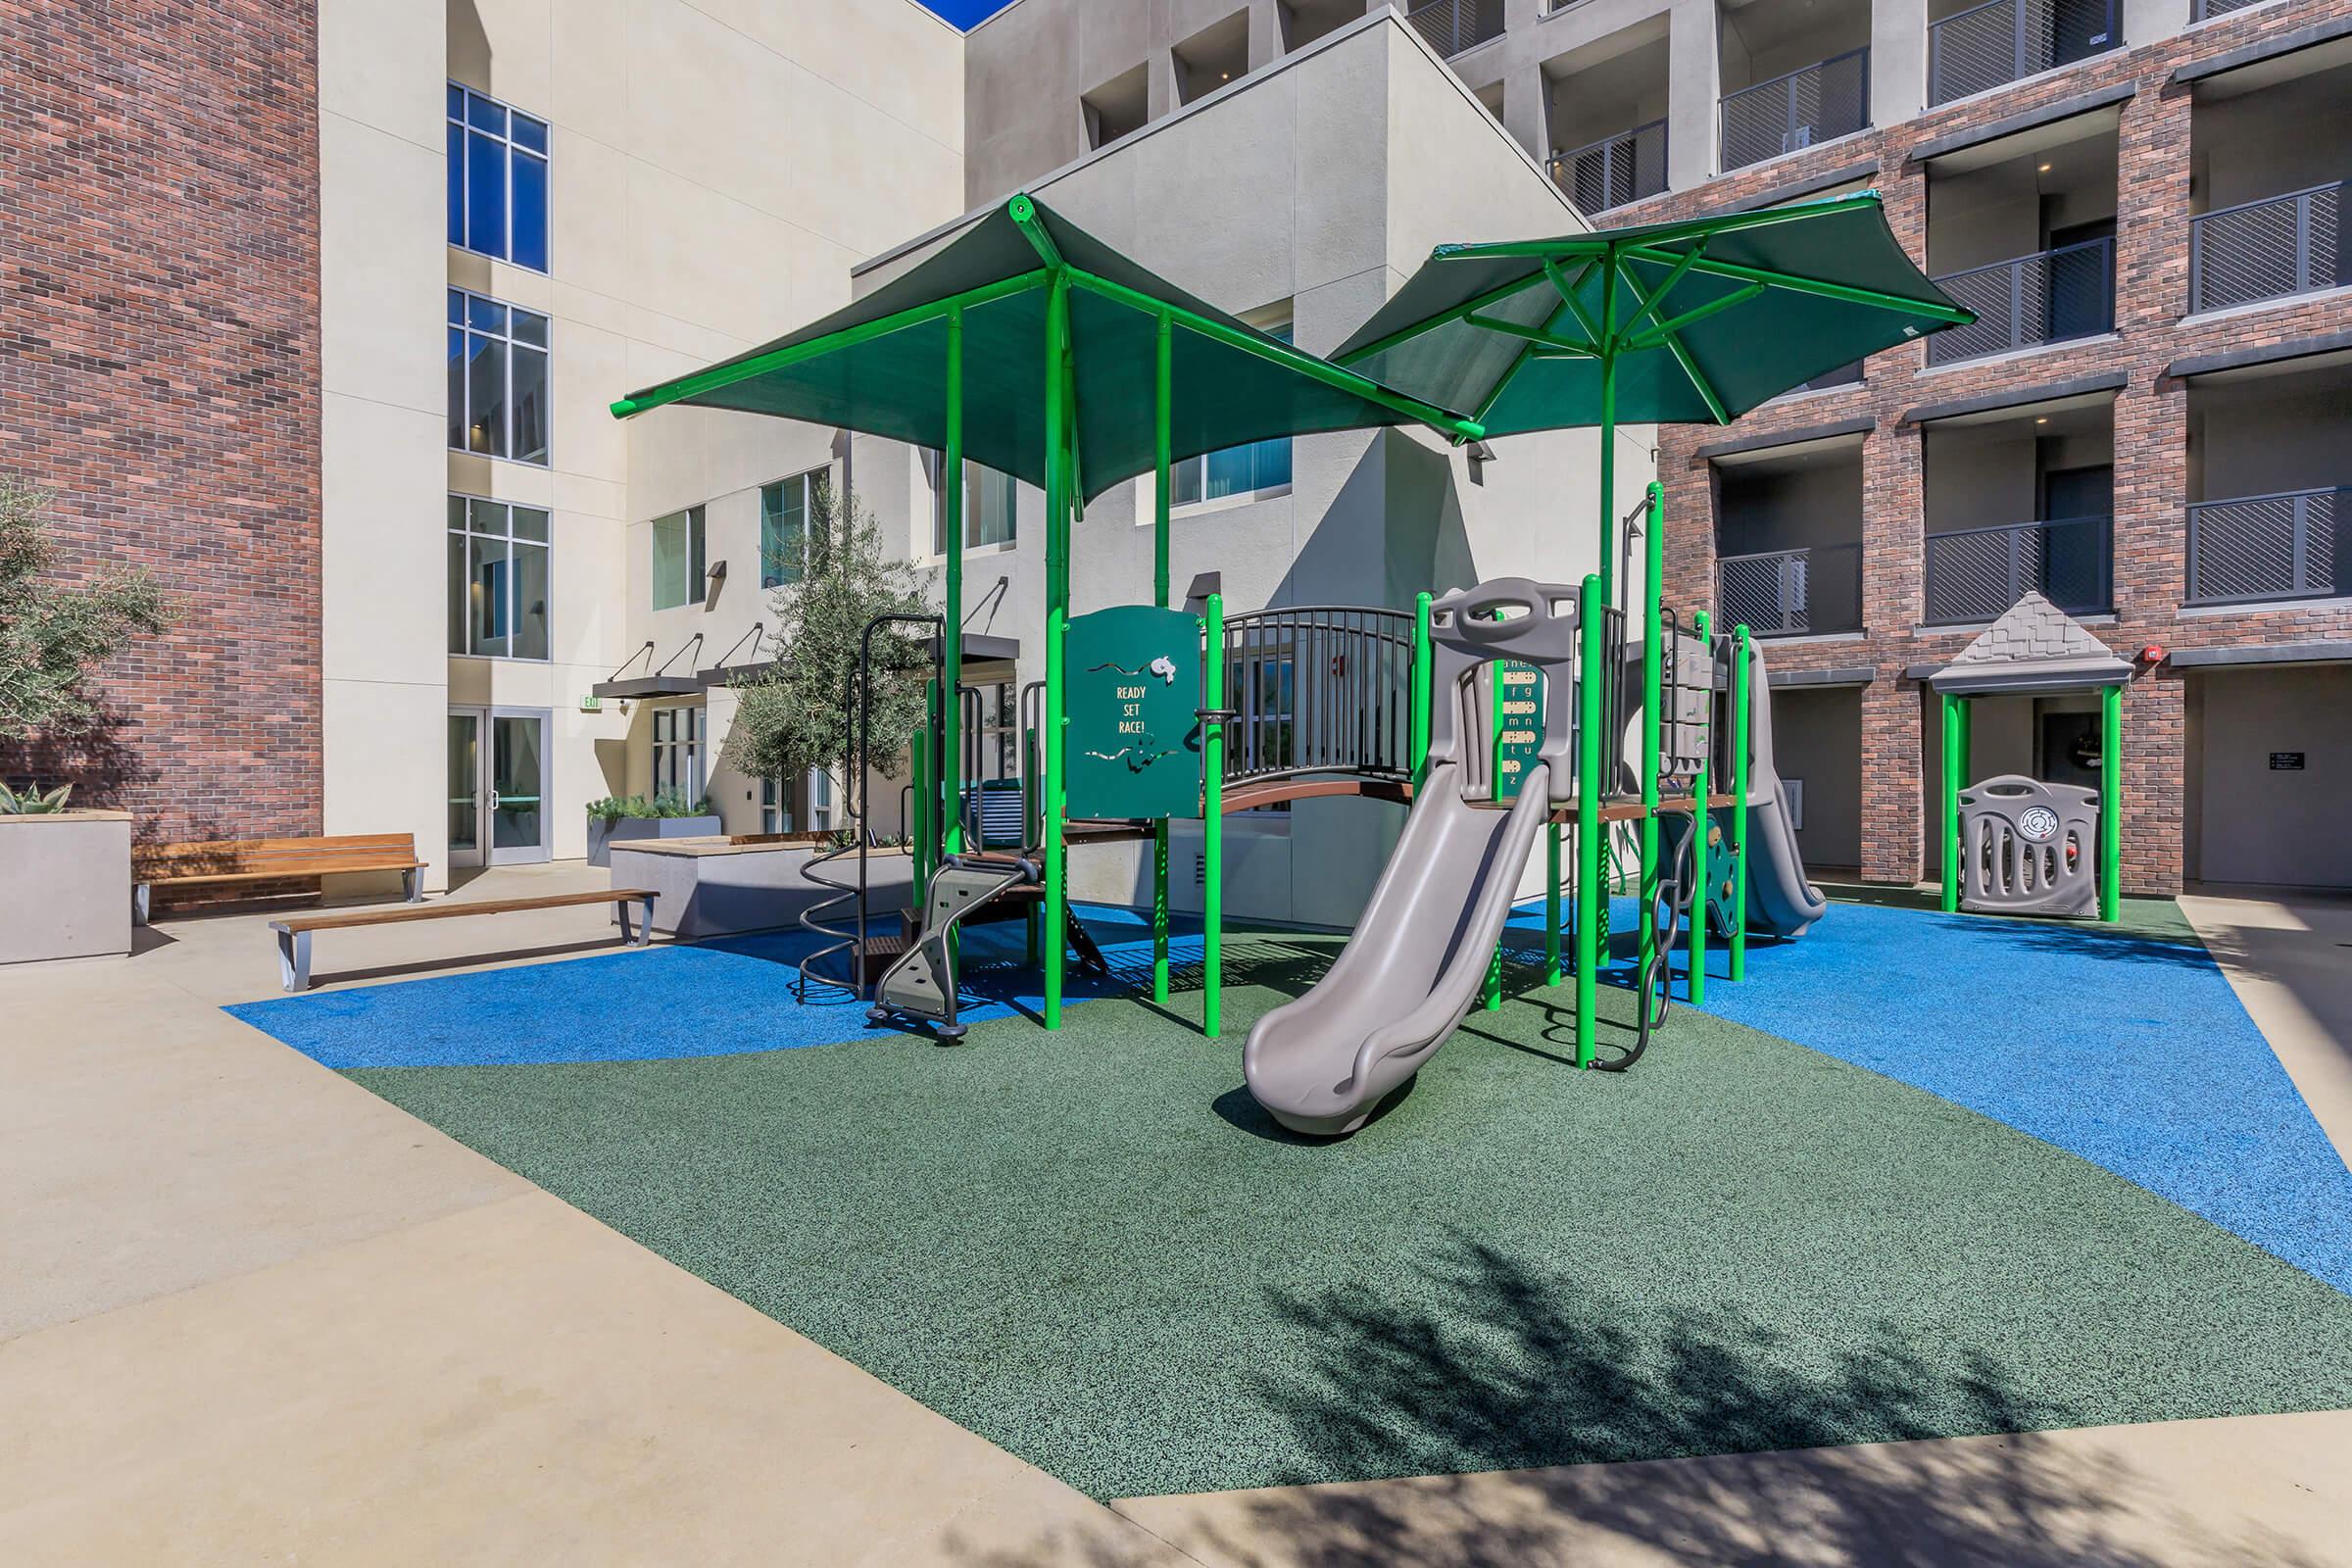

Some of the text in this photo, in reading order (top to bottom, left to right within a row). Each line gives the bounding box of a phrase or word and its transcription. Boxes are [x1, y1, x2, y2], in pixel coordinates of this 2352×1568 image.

[1117, 686, 1146, 699] READY
[1525, 687, 1532, 697] g
[584, 697, 598, 707] EXIT
[1123, 704, 1140, 716] SET
[1509, 717, 1532, 726] m n
[1119, 721, 1145, 734] RACE!
[1510, 776, 1517, 785] z
